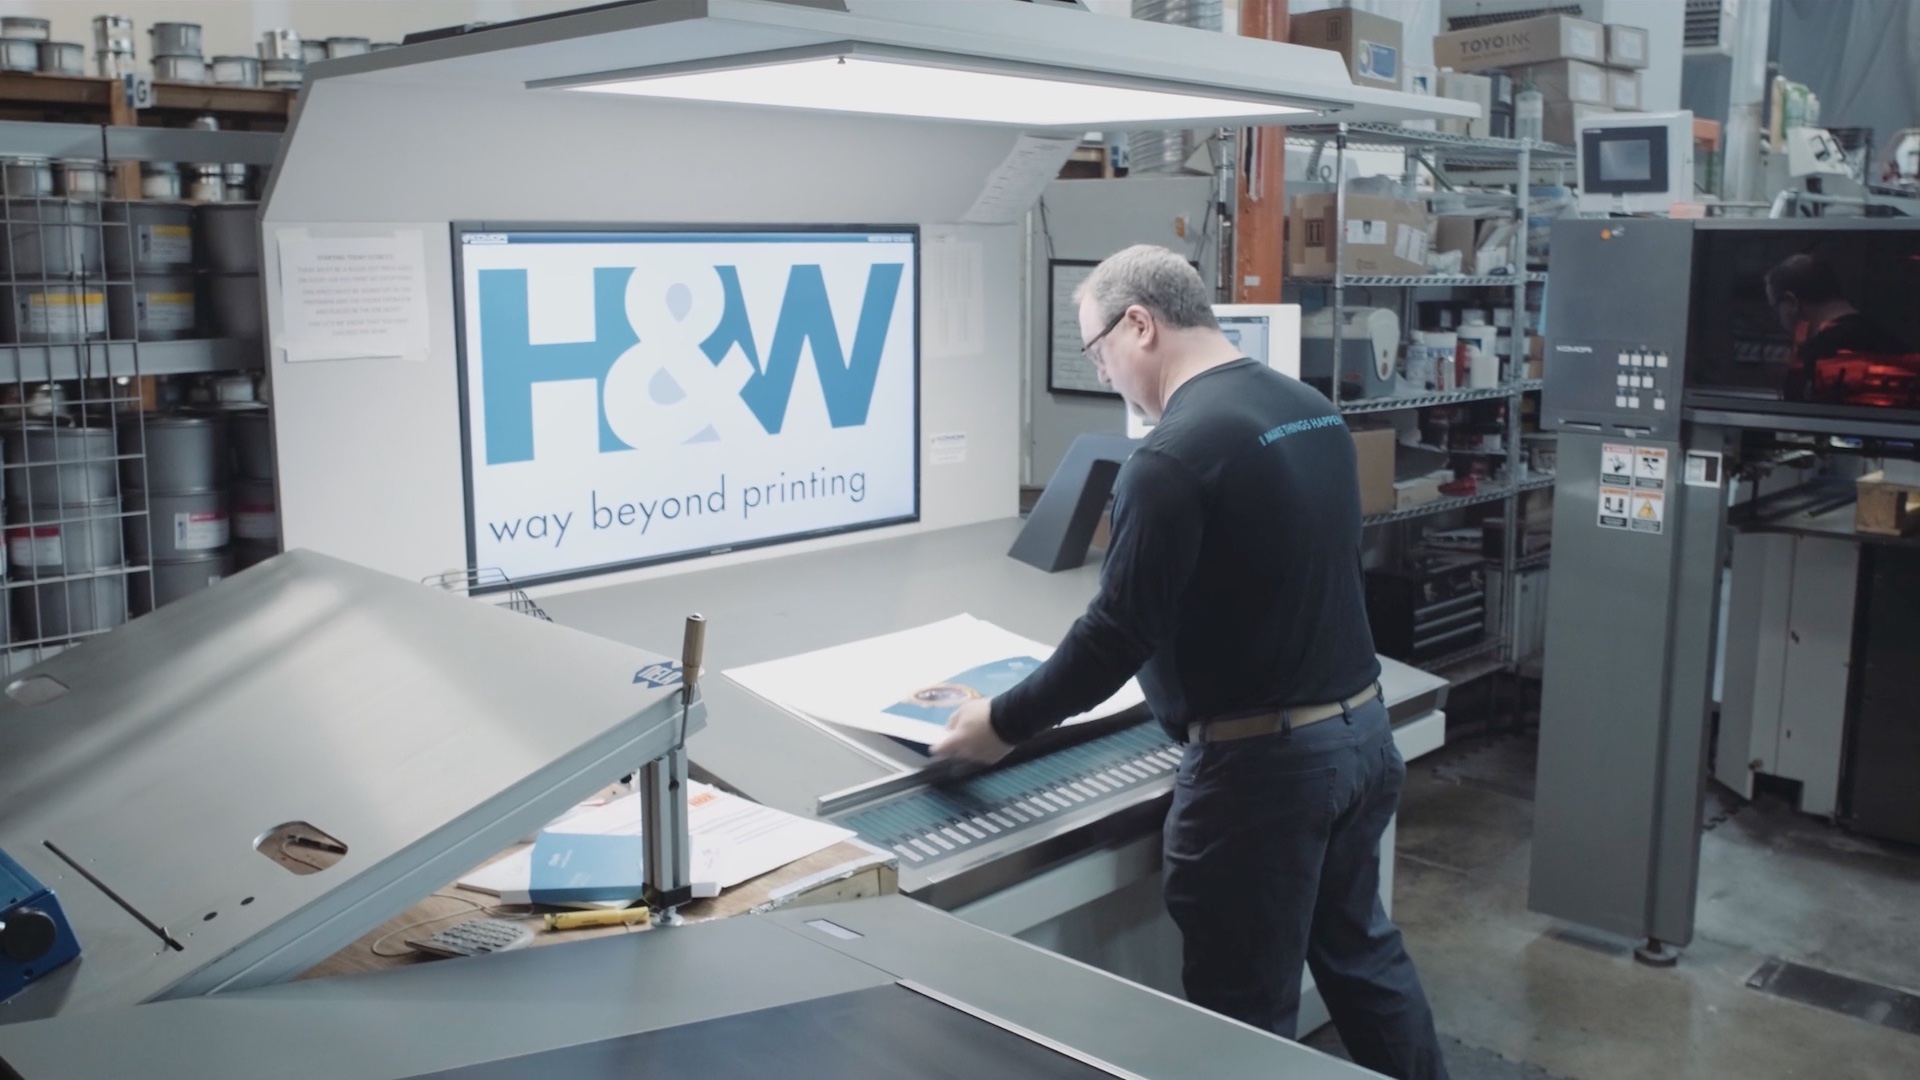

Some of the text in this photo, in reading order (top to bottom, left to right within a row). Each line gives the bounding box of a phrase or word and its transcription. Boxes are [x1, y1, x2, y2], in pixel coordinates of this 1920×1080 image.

[136, 80, 147, 103] G
[479, 263, 904, 465] H&W
[1283, 419, 1311, 436] THINGS
[489, 467, 867, 547] way beyond printing
